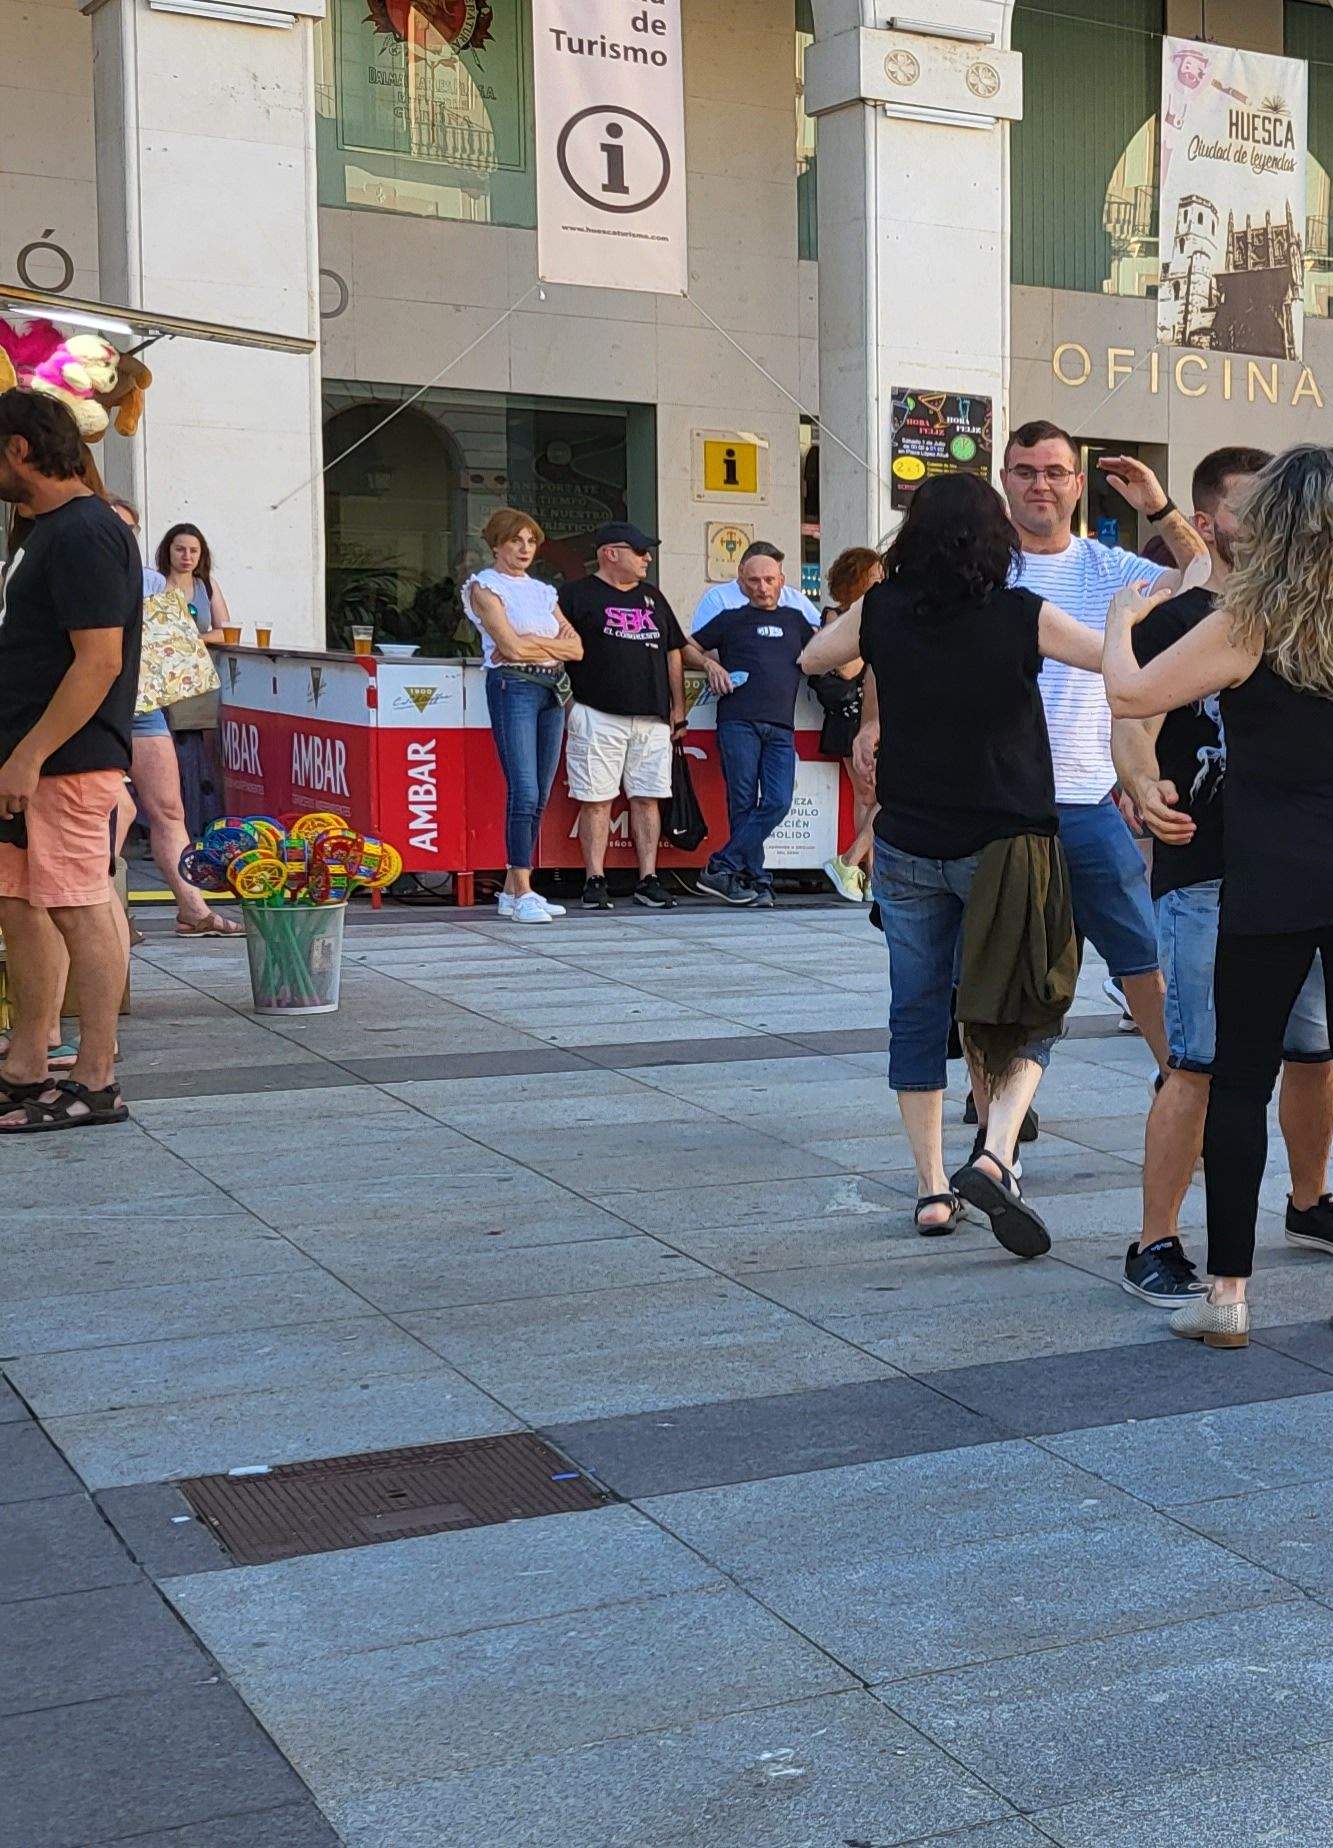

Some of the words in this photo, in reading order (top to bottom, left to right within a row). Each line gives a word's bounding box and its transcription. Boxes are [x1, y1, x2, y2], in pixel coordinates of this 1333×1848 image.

[631, 10, 667, 36] de
[549, 28, 668, 67] Turismo
[1229, 109, 1295, 150] HUESCA
[1188, 134, 1231, 162] Ciudad
[1234, 145, 1248, 164] de
[1250, 145, 1298, 175] leyendas
[561, 224, 670, 242] www.huescaturismo.com
[17, 228, 75, 294] Ó
[1052, 342, 1325, 408] OFICINA
[946, 416, 970, 425] HORA
[956, 425, 981, 434] FELIZ
[221, 720, 263, 777] MBAR
[292, 732, 350, 798] AMBAR
[407, 738, 439, 854] AMBAR
[791, 808, 819, 816] PULO
[794, 798, 813, 806] EZA
[782, 819, 810, 828] CIÉN
